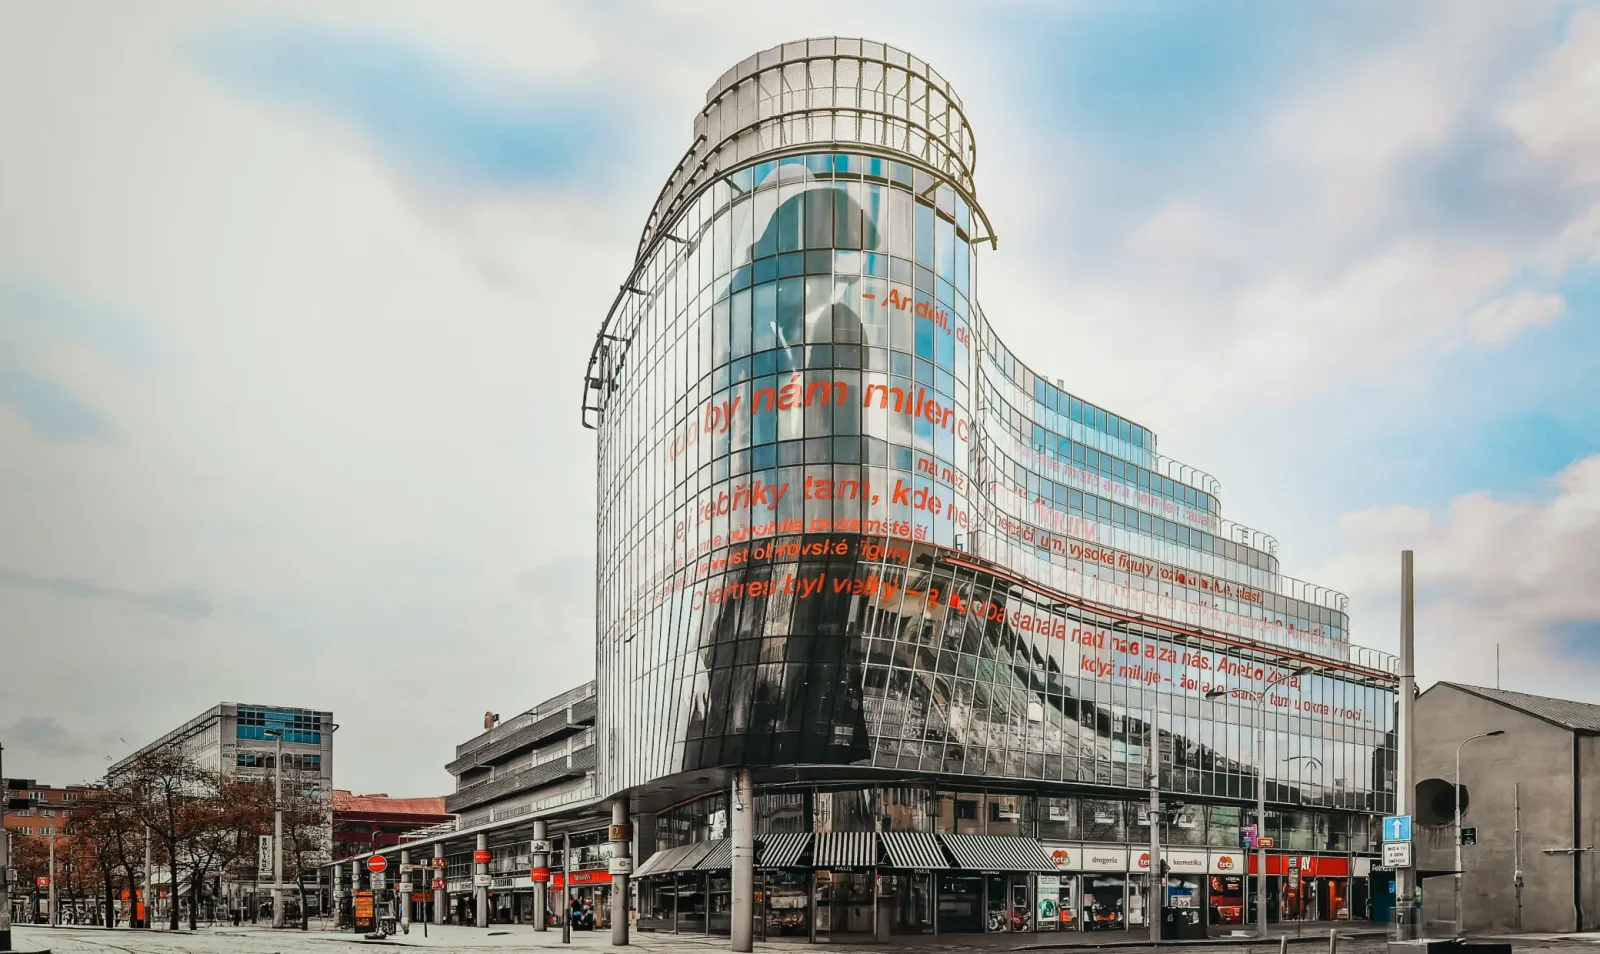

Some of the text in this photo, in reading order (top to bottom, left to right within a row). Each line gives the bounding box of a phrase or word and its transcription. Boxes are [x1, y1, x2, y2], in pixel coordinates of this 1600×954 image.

[704, 395, 742, 435] by
[752, 374, 848, 416] nám
[804, 475, 880, 505] tam,
[893, 479, 942, 515] kde
[1071, 627, 1105, 649] nad
[1092, 856, 1118, 865] drogerie
[1172, 858, 1202, 867] kosmetika
